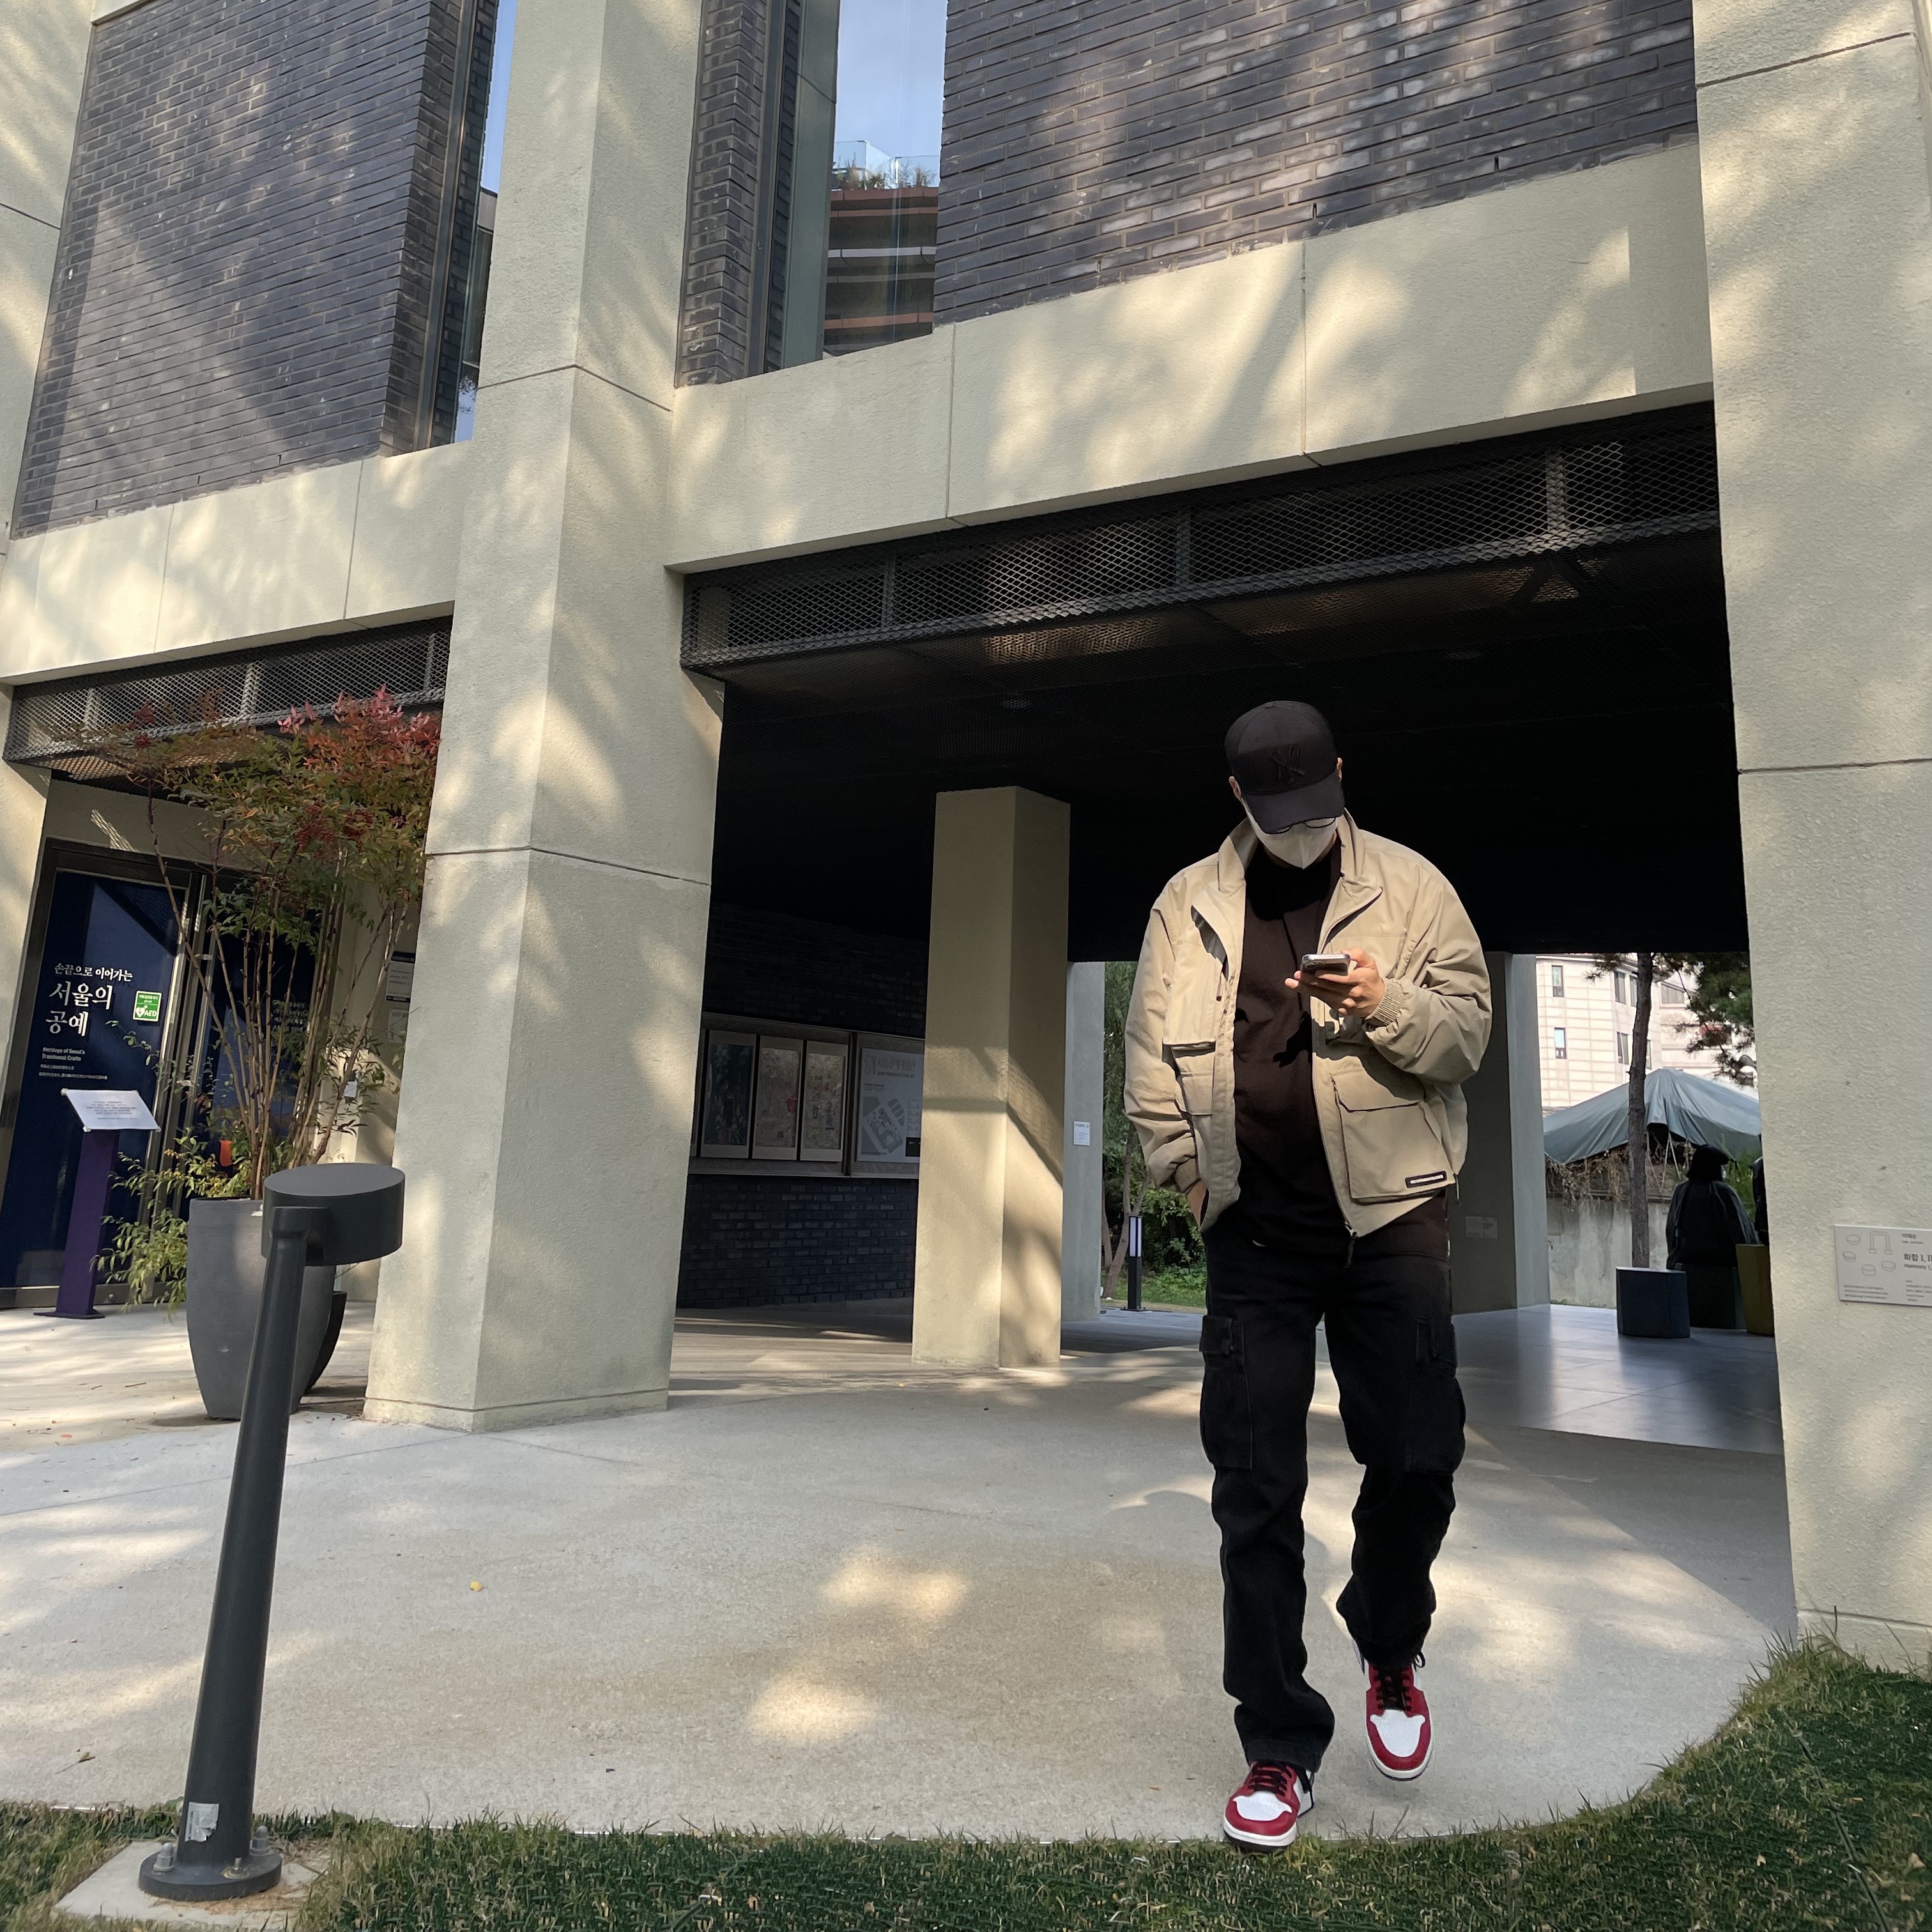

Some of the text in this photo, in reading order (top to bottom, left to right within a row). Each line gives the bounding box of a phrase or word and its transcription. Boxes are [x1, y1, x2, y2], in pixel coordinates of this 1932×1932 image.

[54, 963, 133, 982] 손끝으로 이어가는
[49, 981, 113, 1010] 서울의
[45, 1010, 89, 1036] 공예
